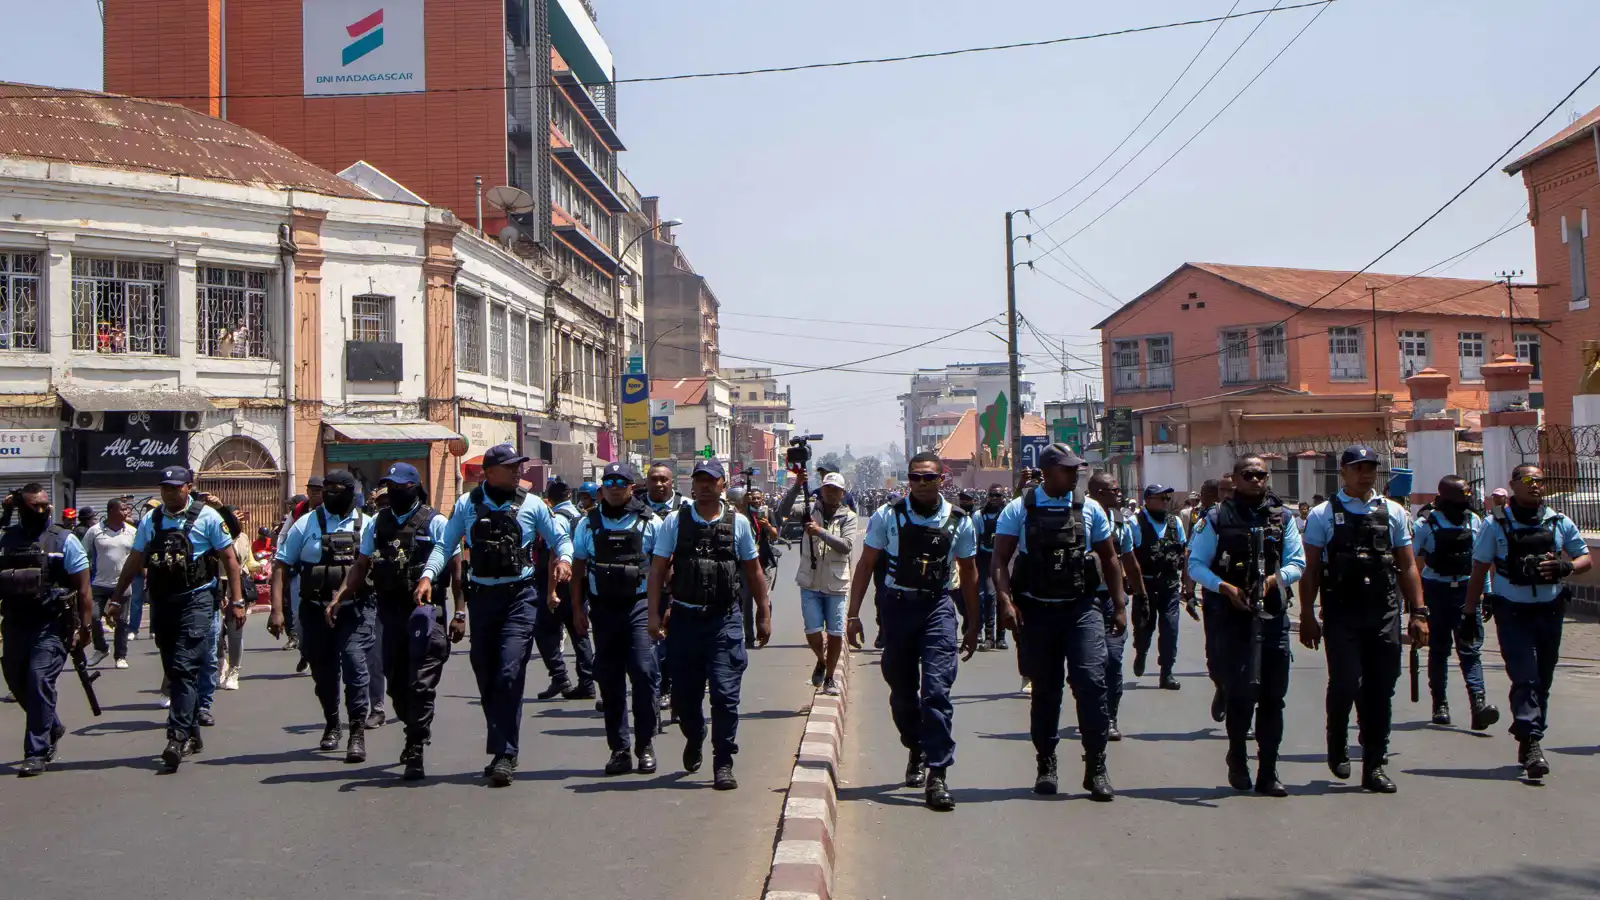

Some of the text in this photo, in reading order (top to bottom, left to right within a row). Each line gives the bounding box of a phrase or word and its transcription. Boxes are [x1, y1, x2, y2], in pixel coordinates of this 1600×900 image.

[336, 72, 413, 82] MADAGASCAR
[101, 437, 179, 456] All-Wish
[125, 456, 154, 470] Bijoux
